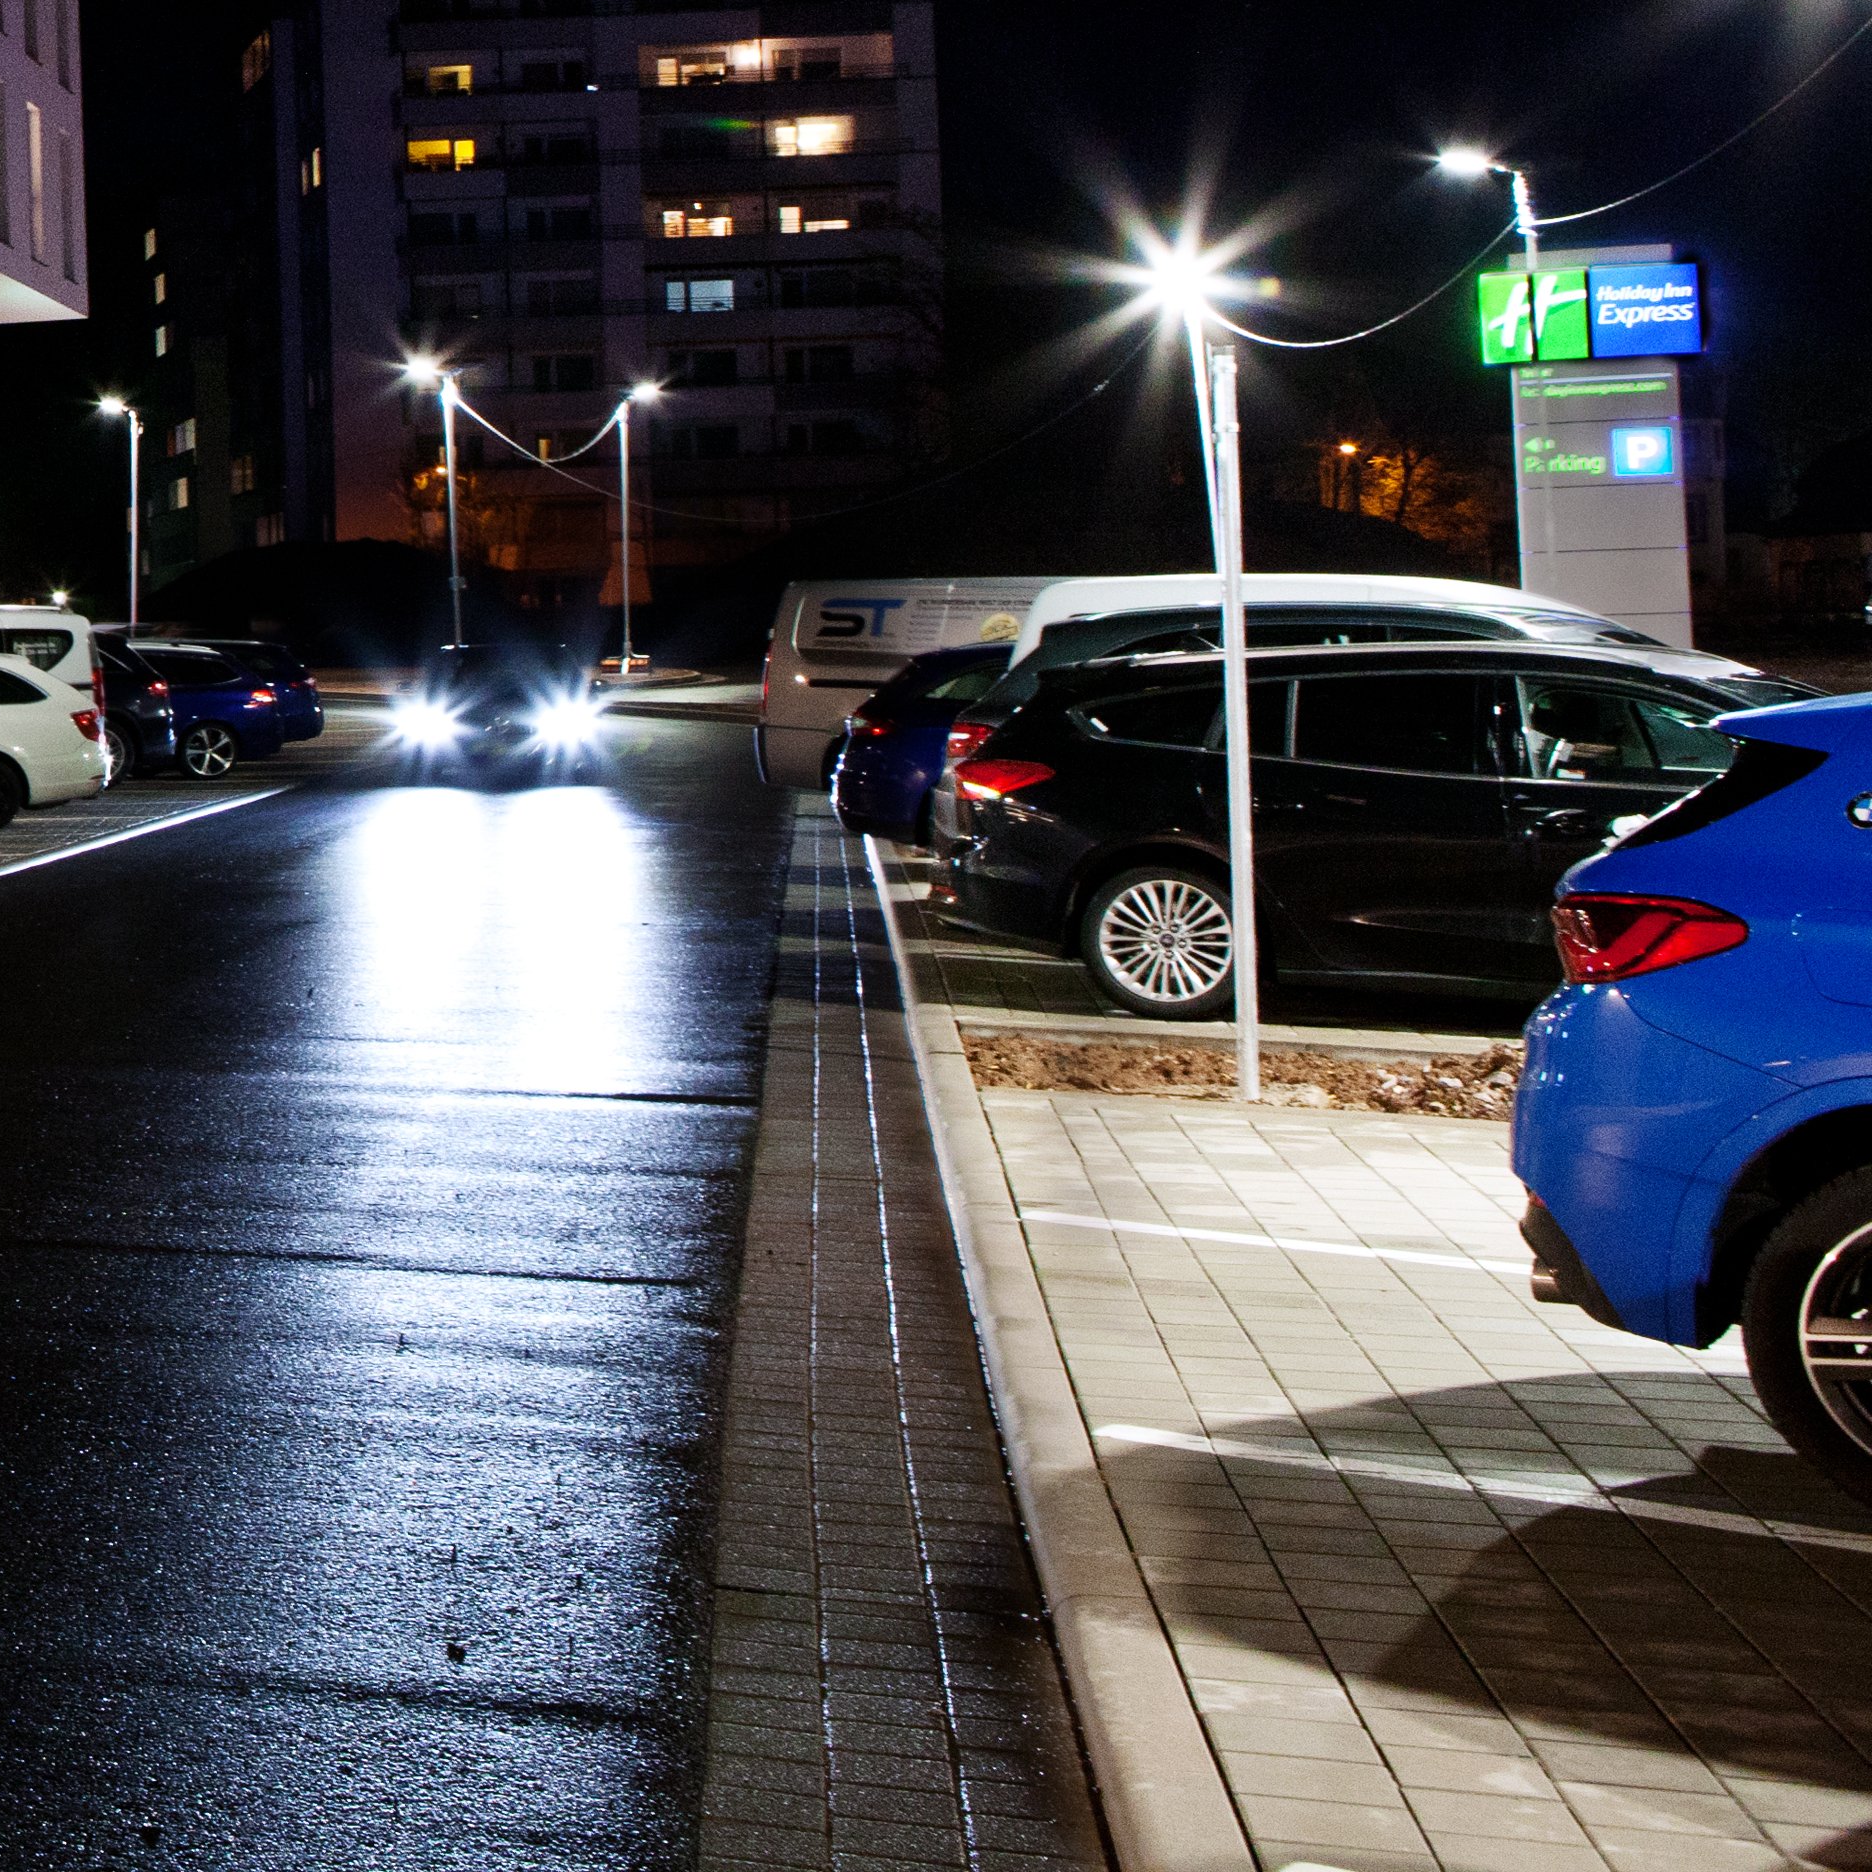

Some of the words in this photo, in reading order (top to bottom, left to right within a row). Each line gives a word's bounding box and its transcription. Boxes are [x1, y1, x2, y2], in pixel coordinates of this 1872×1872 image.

[1595, 284, 1663, 302] Holiday
[1663, 282, 1693, 298] Inn
[1596, 302, 1694, 328] Express
[1626, 435, 1659, 470] P
